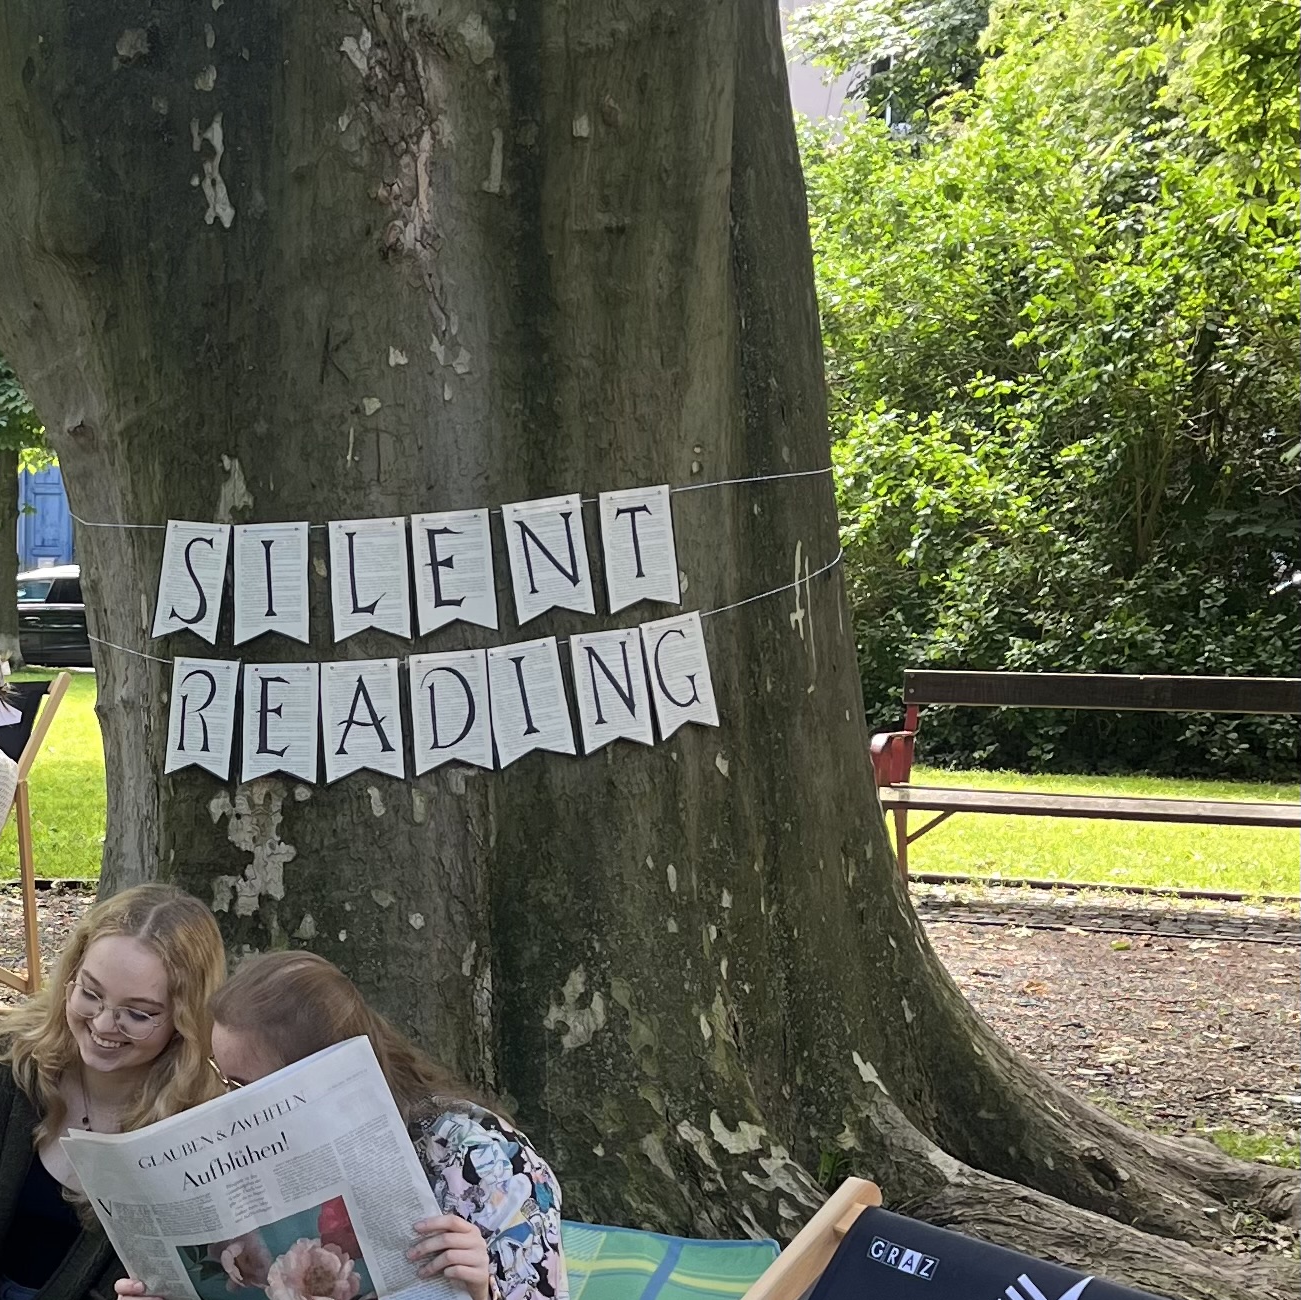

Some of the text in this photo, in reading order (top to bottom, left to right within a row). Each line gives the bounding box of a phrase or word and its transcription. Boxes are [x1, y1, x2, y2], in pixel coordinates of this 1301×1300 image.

[167, 503, 654, 626] SILENT
[175, 629, 702, 759] READING
[137, 1093, 308, 1170] GLAUBEN & ZWEIFELN
[181, 1130, 290, 1192] Aufblühen!
[870, 1240, 935, 1277] GRAZ
